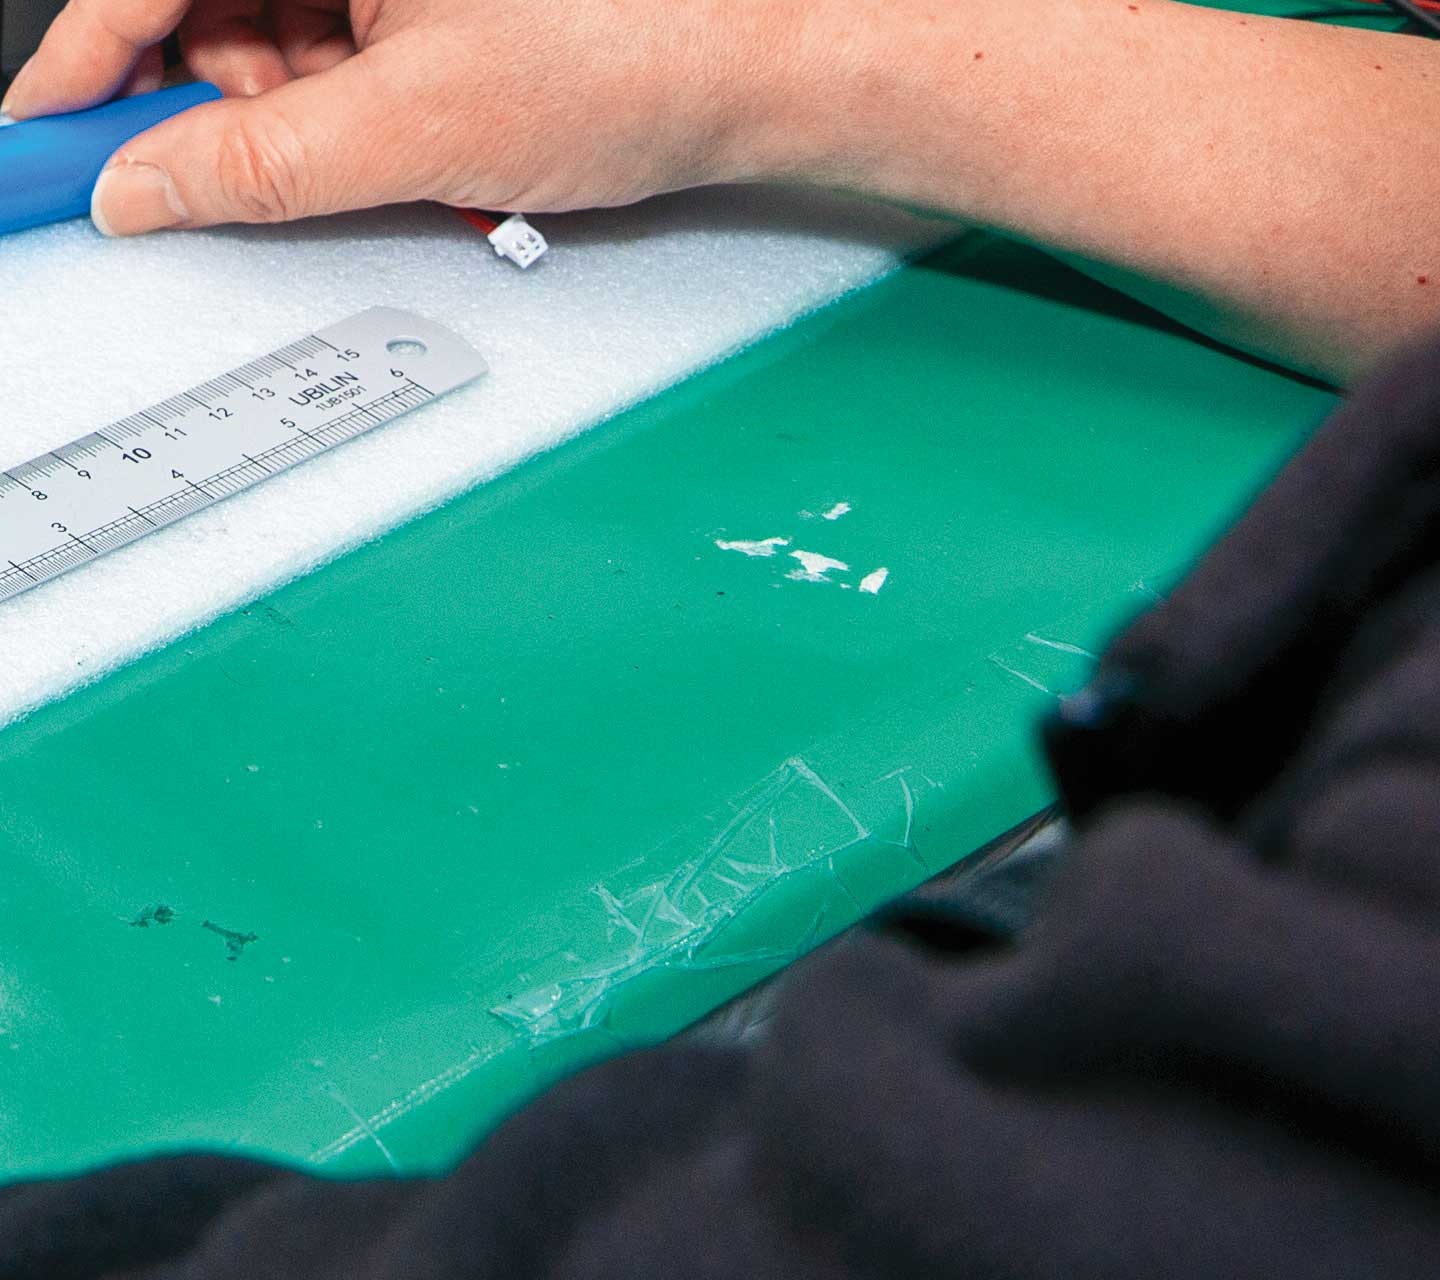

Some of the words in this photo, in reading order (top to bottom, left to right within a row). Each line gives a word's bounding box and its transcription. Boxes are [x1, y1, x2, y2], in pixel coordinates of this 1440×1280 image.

[31, 489, 49, 502] 8
[76, 468, 93, 481] 9
[121, 446, 153, 465] 10
[163, 426, 188, 441] 11
[208, 406, 235, 422] 12
[250, 386, 277, 402] 13
[294, 367, 319, 382] 14
[336, 348, 361, 363] 15
[288, 370, 359, 407] UBILIN
[314, 384, 368, 412] 1UB1501
[50, 520, 69, 534] 3
[169, 468, 186, 481] 4
[279, 416, 297, 430] 5
[389, 367, 405, 379] 6
